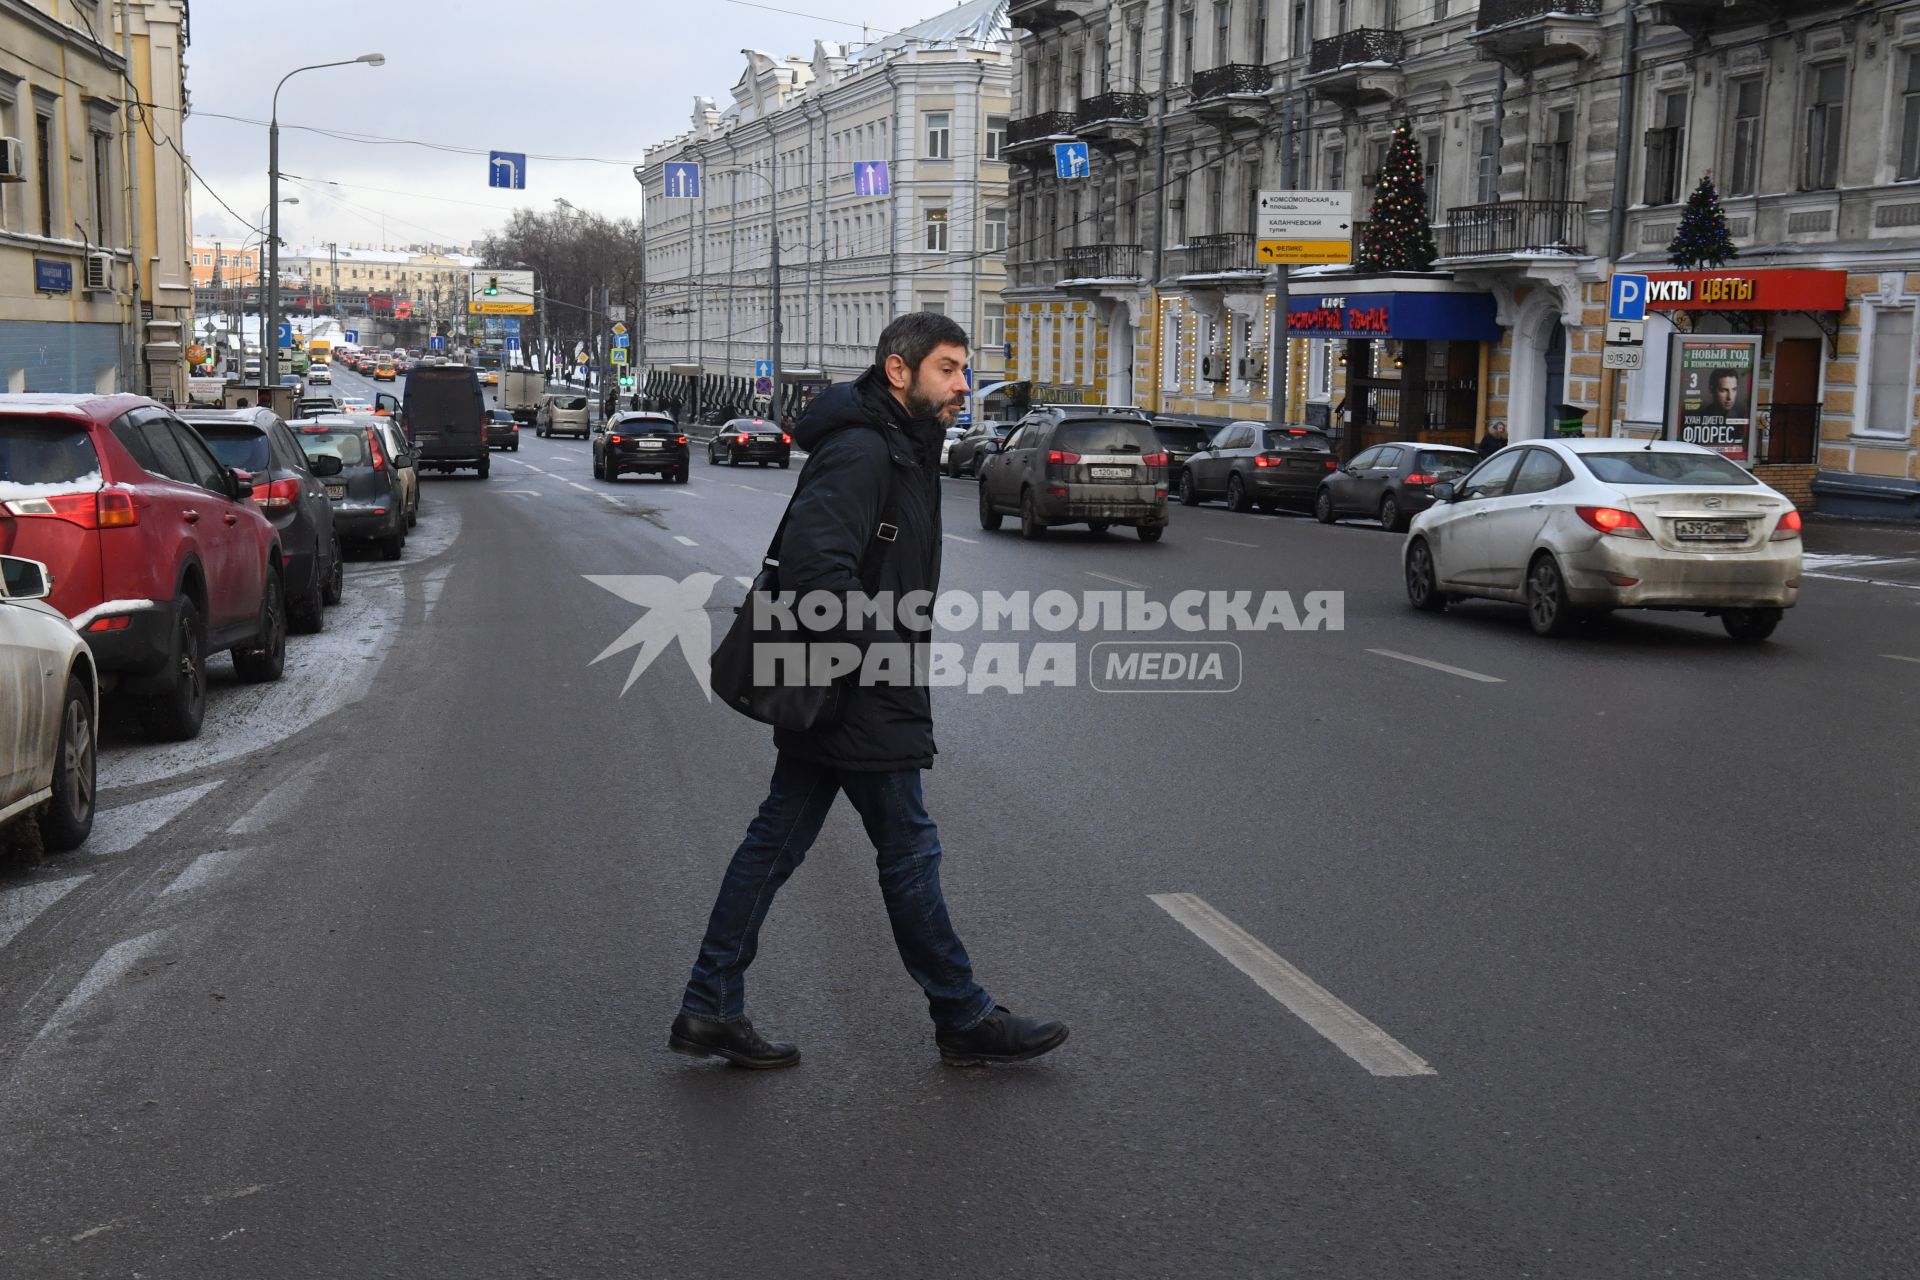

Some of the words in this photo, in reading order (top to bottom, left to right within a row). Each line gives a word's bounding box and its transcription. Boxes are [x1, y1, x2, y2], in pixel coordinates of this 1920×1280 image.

[1700, 279, 1753, 303] ЦВЕТЫ
[1321, 297, 1346, 308] КАФЕ
[1616, 353, 1623, 362] 15
[1626, 353, 1638, 363] 20
[1691, 349, 1727, 360] НОВЫЙ
[1730, 349, 1750, 361] ГОД
[1689, 372, 1698, 389] 3
[1684, 415, 1701, 425] ХУАН
[1702, 415, 1724, 426] ДИЕГО
[1683, 425, 1735, 443] ФЛОРЕС
